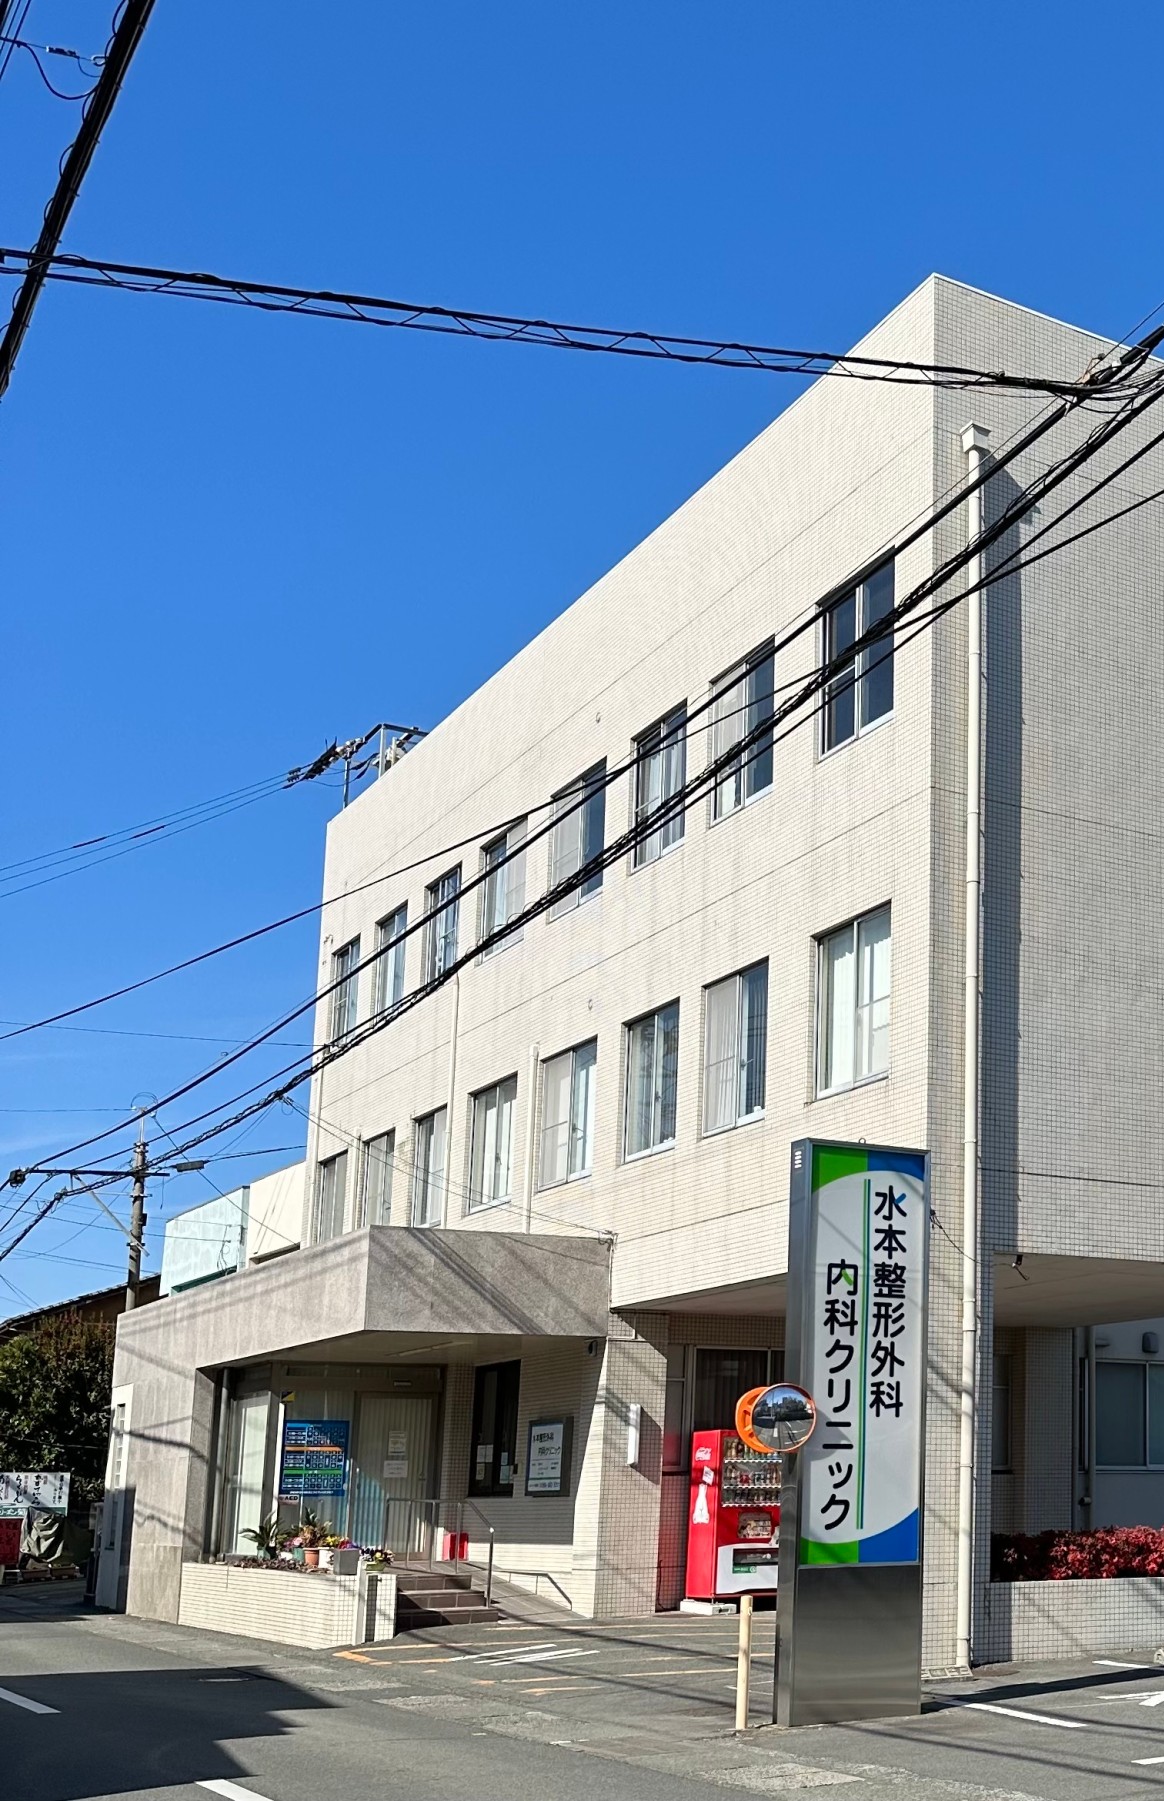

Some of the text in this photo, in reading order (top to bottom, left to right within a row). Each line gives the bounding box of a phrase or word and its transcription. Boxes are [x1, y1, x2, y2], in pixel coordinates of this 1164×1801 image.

[820, 1258, 859, 1531] 内科クリニック
[869, 1184, 907, 1418] 水本整形外科
